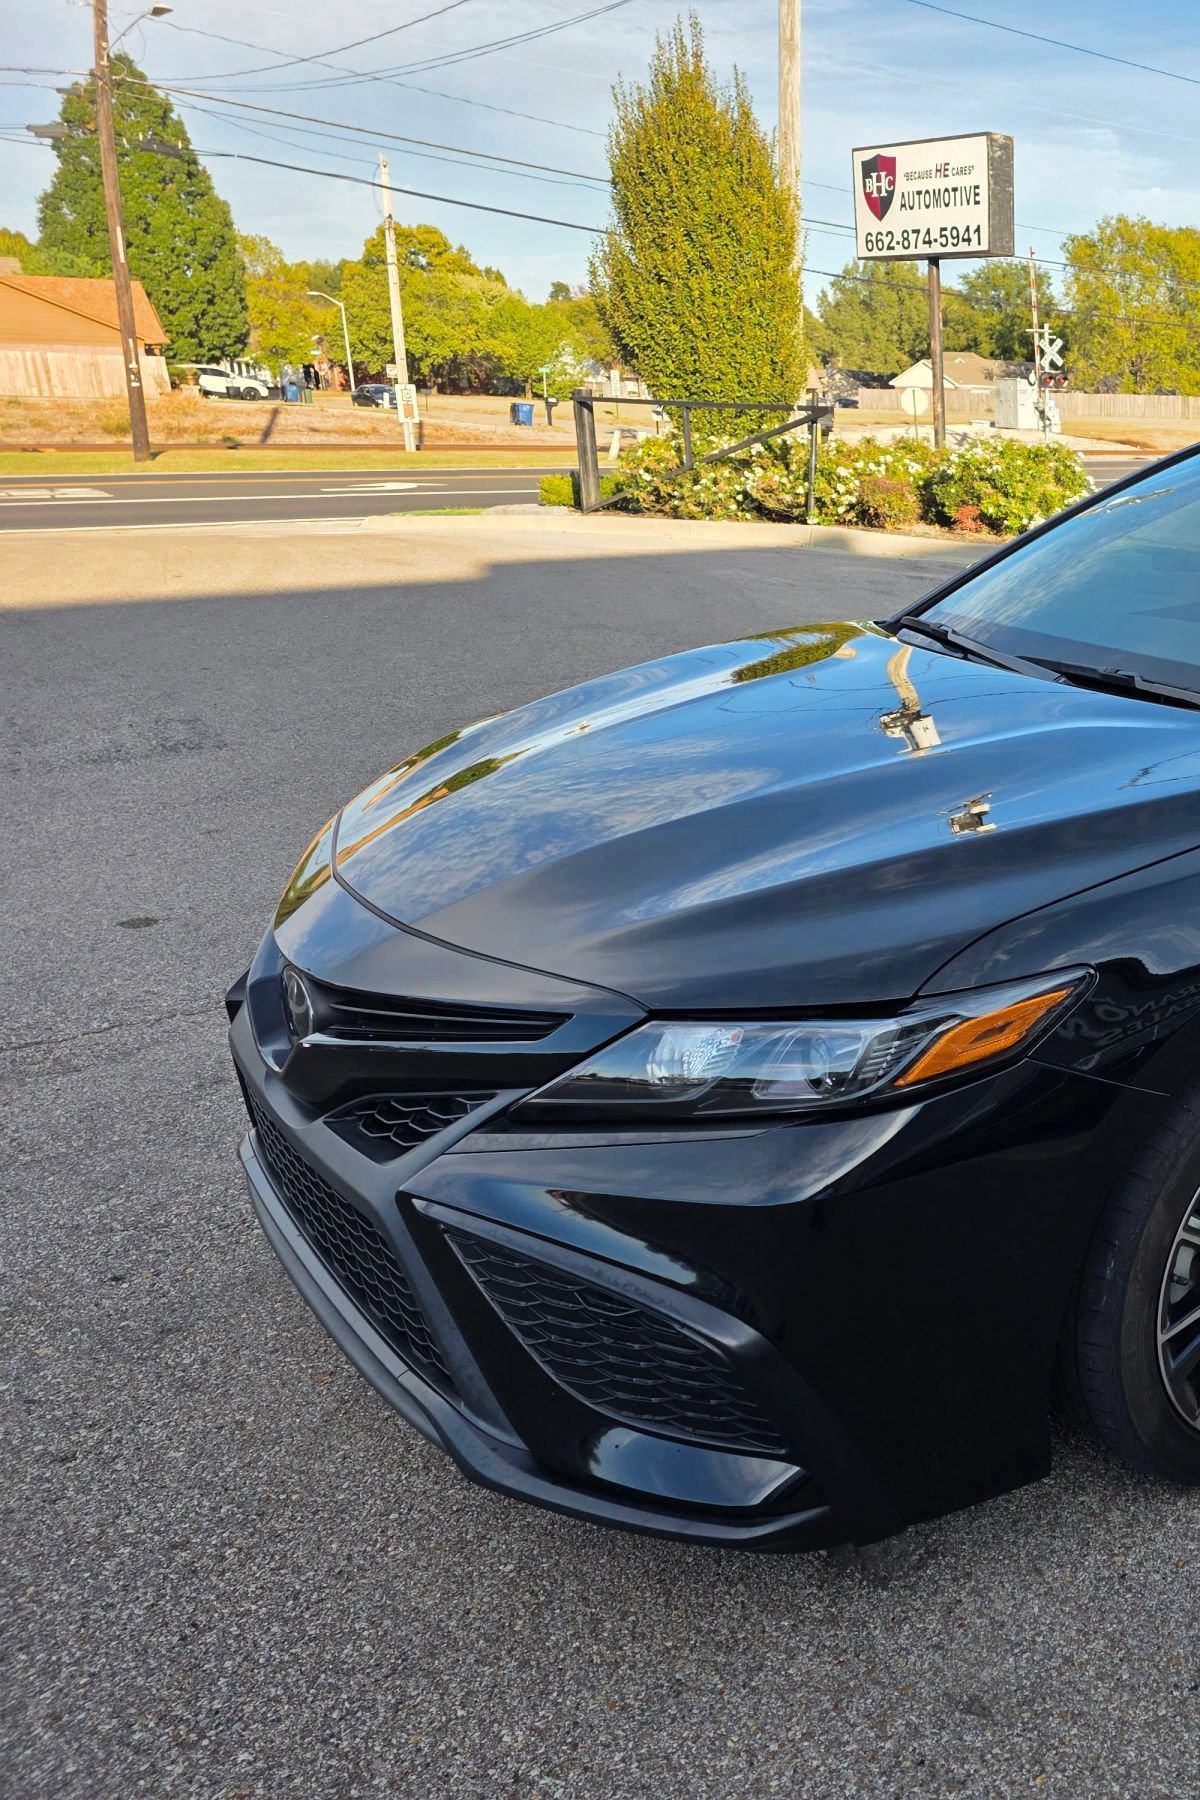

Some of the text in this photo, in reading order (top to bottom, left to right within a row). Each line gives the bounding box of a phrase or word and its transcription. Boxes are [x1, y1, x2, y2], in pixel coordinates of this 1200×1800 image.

[934, 162, 950, 179] HE
[865, 171, 894, 198] BHC
[899, 184, 981, 212] AUTOMOTIVE
[865, 223, 982, 253] 662-874-5941
